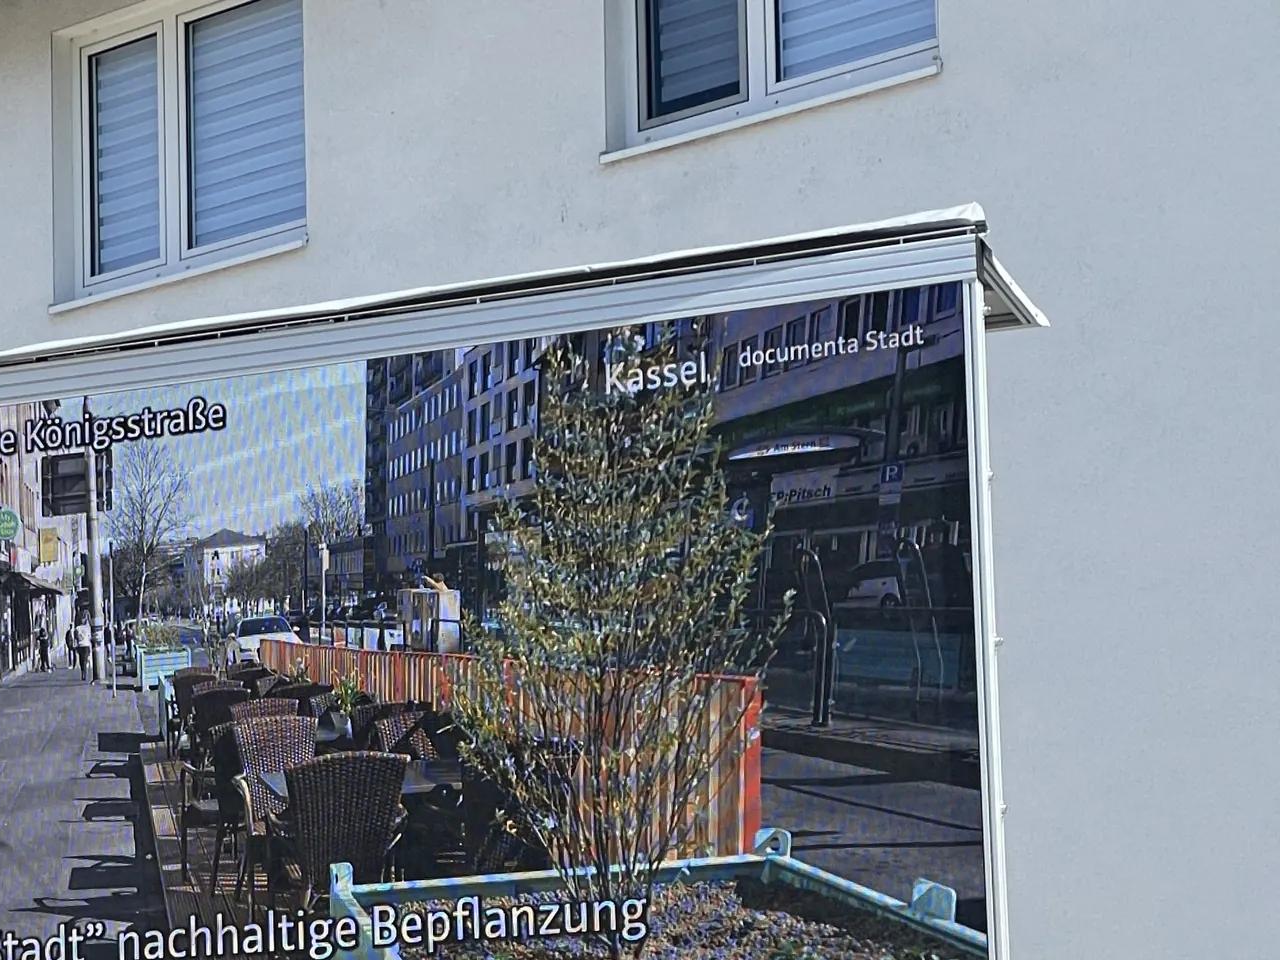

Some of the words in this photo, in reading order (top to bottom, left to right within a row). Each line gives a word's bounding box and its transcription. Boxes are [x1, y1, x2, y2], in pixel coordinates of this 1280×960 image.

[738, 335, 859, 368] documenta
[865, 324, 925, 352] Stadt
[605, 352, 707, 395] Kassel
[26, 398, 225, 450] Königsstraße
[118, 910, 357, 960] nachhaltige
[372, 895, 648, 952] Bepflanzung
